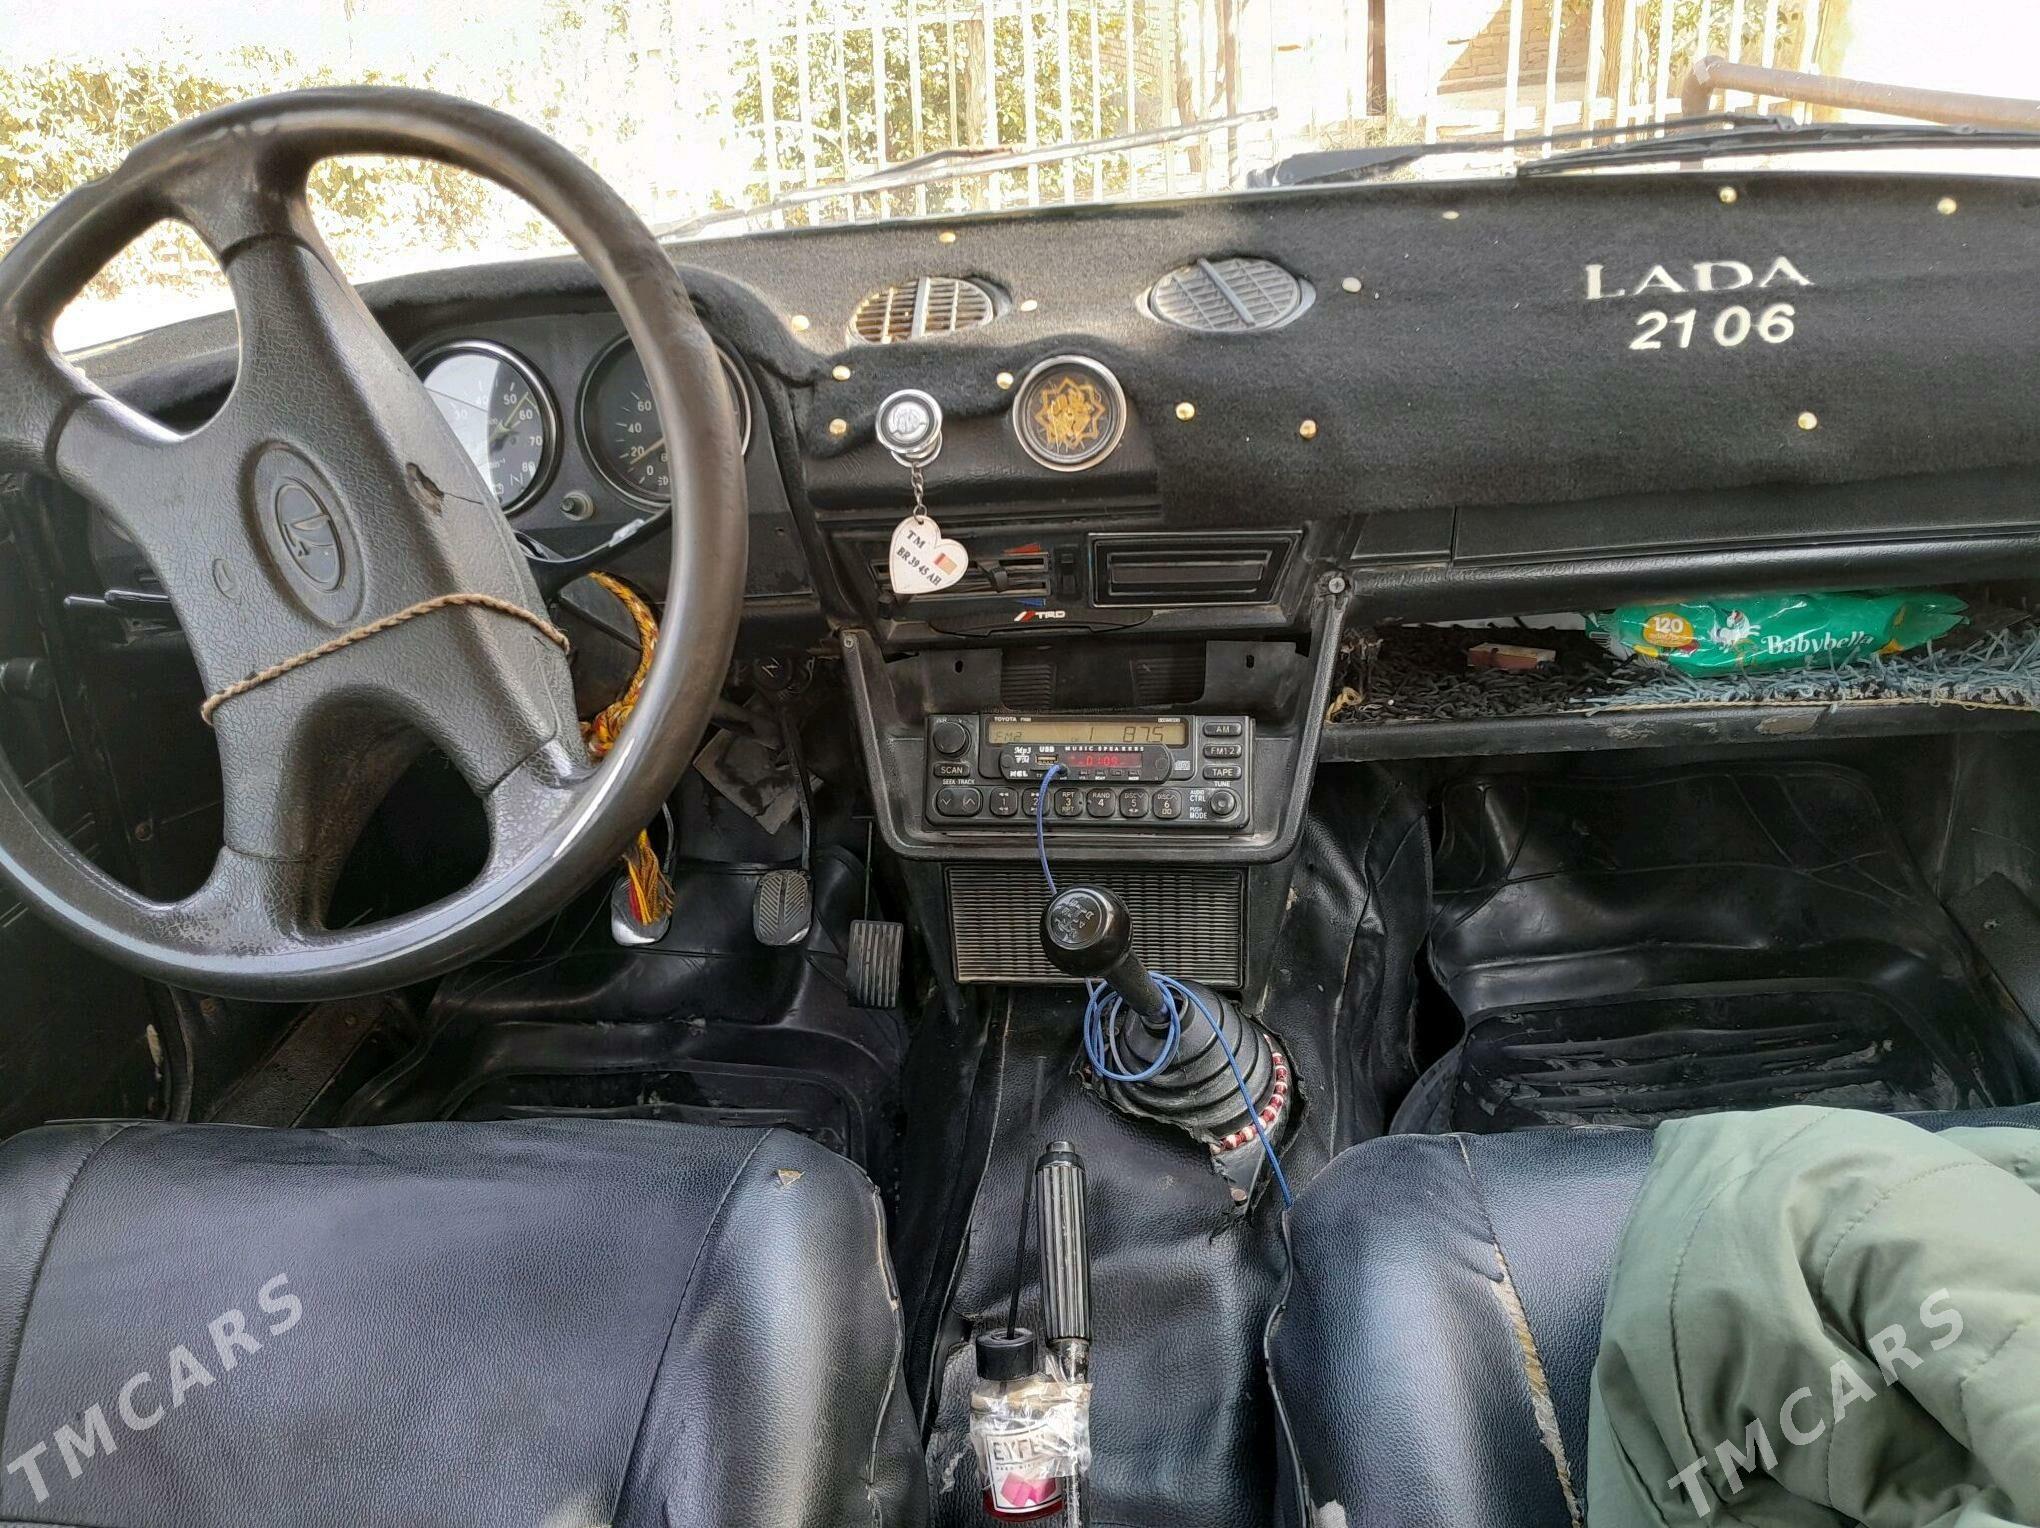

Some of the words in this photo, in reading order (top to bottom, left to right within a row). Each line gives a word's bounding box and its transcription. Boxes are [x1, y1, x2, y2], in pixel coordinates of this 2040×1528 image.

[1586, 256, 1815, 299] LADA
[1628, 303, 1795, 350] 2106
[504, 394, 517, 405] 50
[638, 400, 652, 411] 60
[519, 409, 533, 420] 60
[628, 422, 642, 433] 40
[529, 436, 543, 446] 70
[631, 446, 644, 457] 20
[522, 461, 536, 472] 80
[646, 465, 654, 475] 0
[907, 530, 926, 549] TM
[896, 546, 911, 561] BR
[908, 557, 920, 568] 39
[919, 565, 930, 576] 45
[1035, 610, 1066, 619] TRD
[1655, 616, 1684, 633] 120
[1760, 630, 1874, 655] Babybella
[941, 766, 963, 774] SCAN
[1212, 768, 1234, 776] TAPE
[1034, 798, 1040, 806] 2
[1065, 798, 1072, 806] 3
[1098, 799, 1104, 807] 4
[1164, 801, 1170, 809] 6
